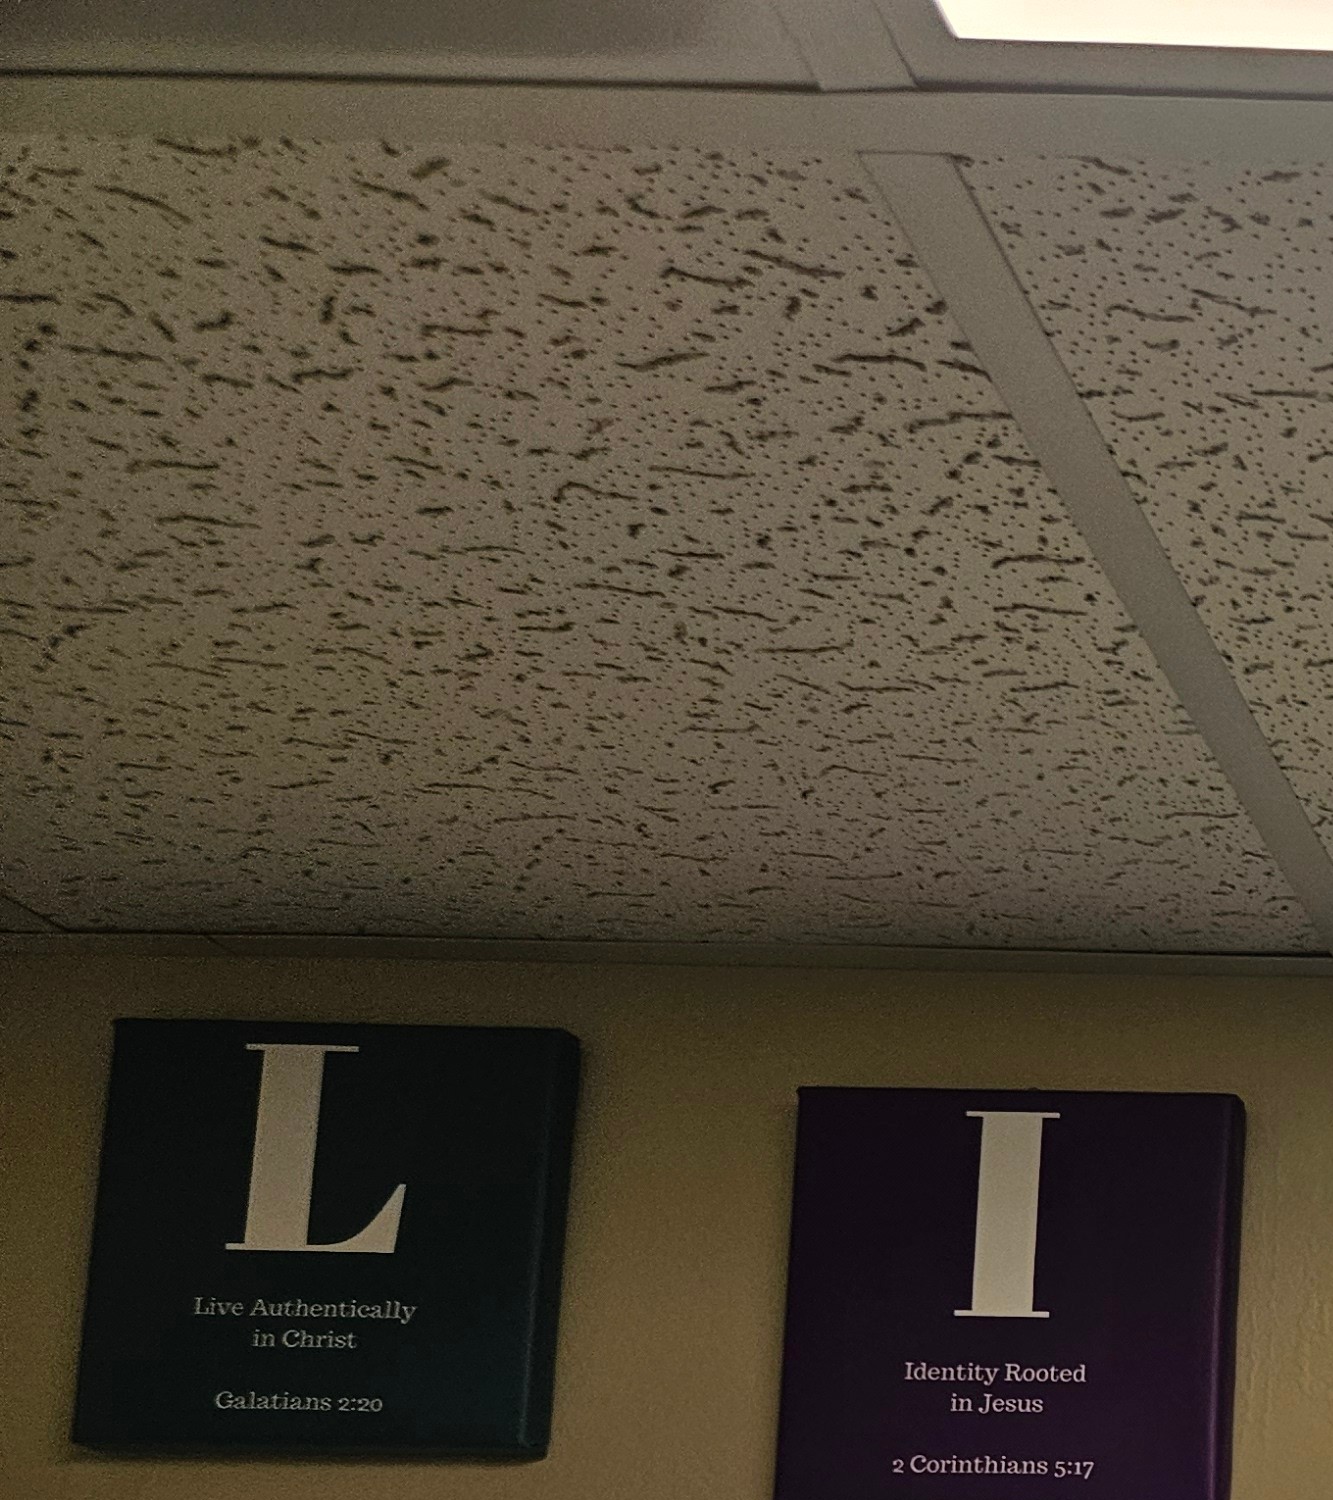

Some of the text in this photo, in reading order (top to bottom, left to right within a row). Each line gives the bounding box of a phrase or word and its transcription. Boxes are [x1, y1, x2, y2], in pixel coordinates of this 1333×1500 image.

[226, 1043, 406, 1253] L
[954, 1110, 1061, 1318] I
[194, 1296, 417, 1323] Live Authentically
[252, 1330, 357, 1349] in Christ
[904, 1362, 1087, 1386] Identity Rooted
[215, 1392, 383, 1412] Galatians 2:20
[950, 1394, 1044, 1414] in Jesus
[892, 1455, 1094, 1479] 2 Corinthians 5:17
